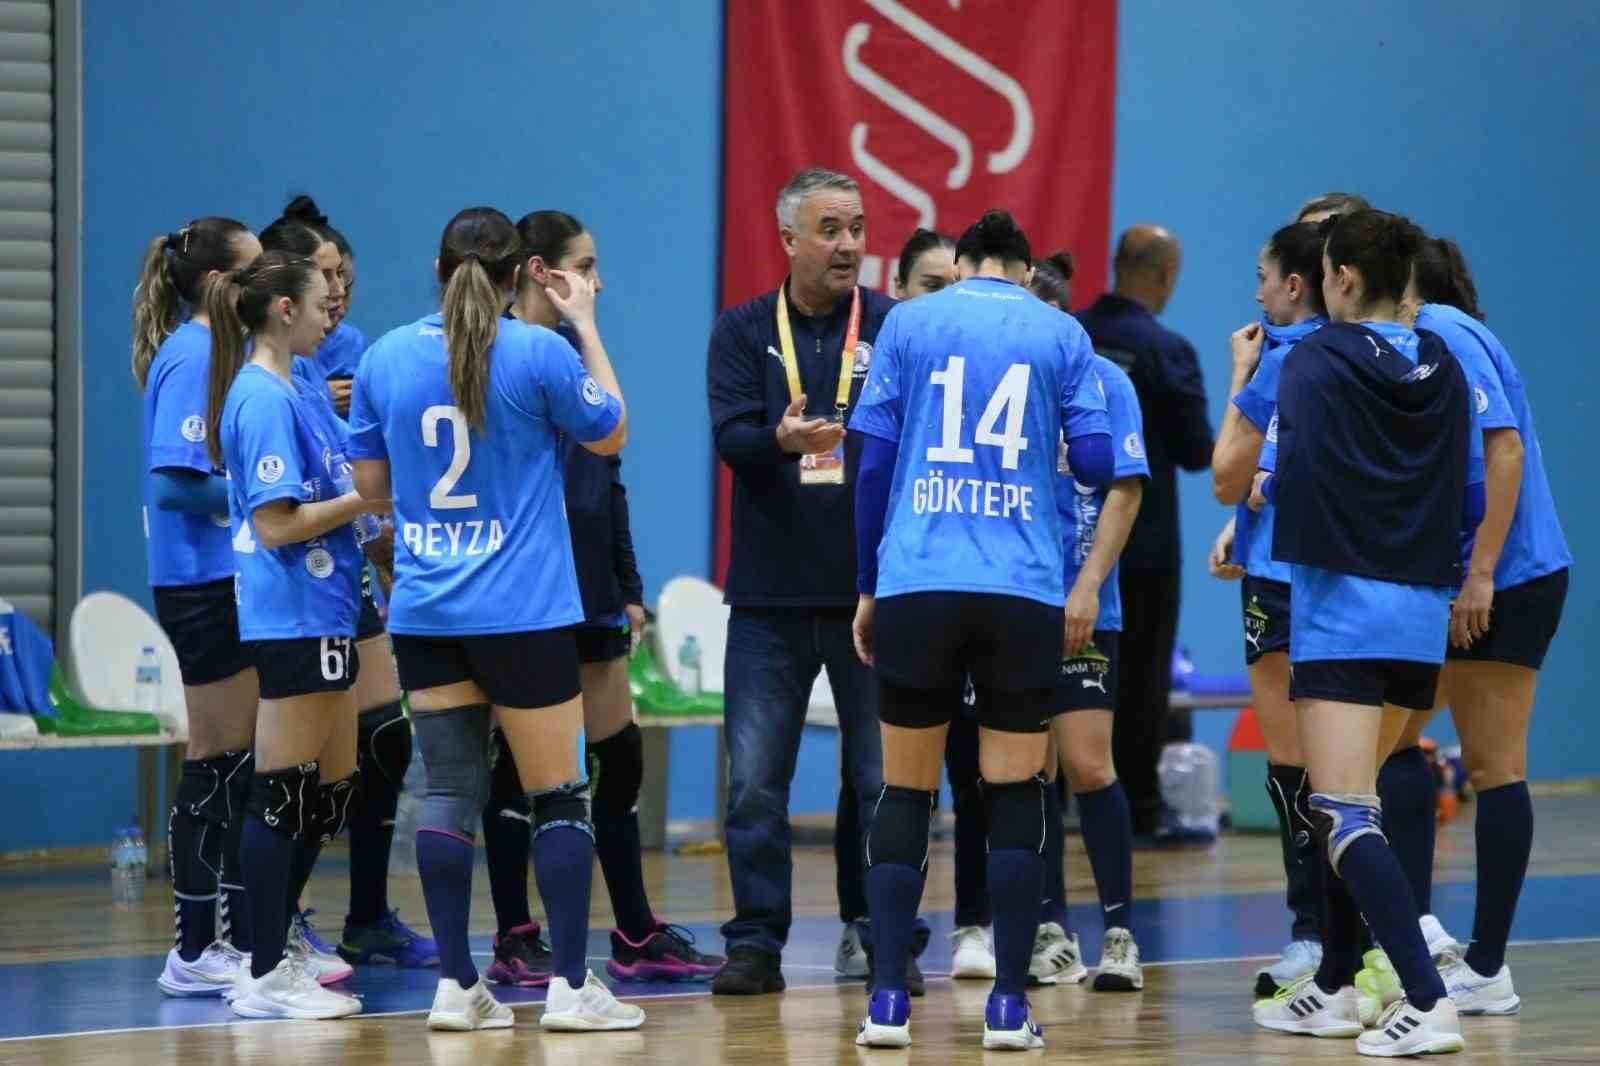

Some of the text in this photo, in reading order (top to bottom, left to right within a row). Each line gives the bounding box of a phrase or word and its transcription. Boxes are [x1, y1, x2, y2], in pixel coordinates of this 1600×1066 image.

[925, 355, 1032, 470] 14
[421, 404, 478, 510] 2
[912, 470, 1034, 521] GÖKTEPE
[402, 519, 506, 557] BEYZA
